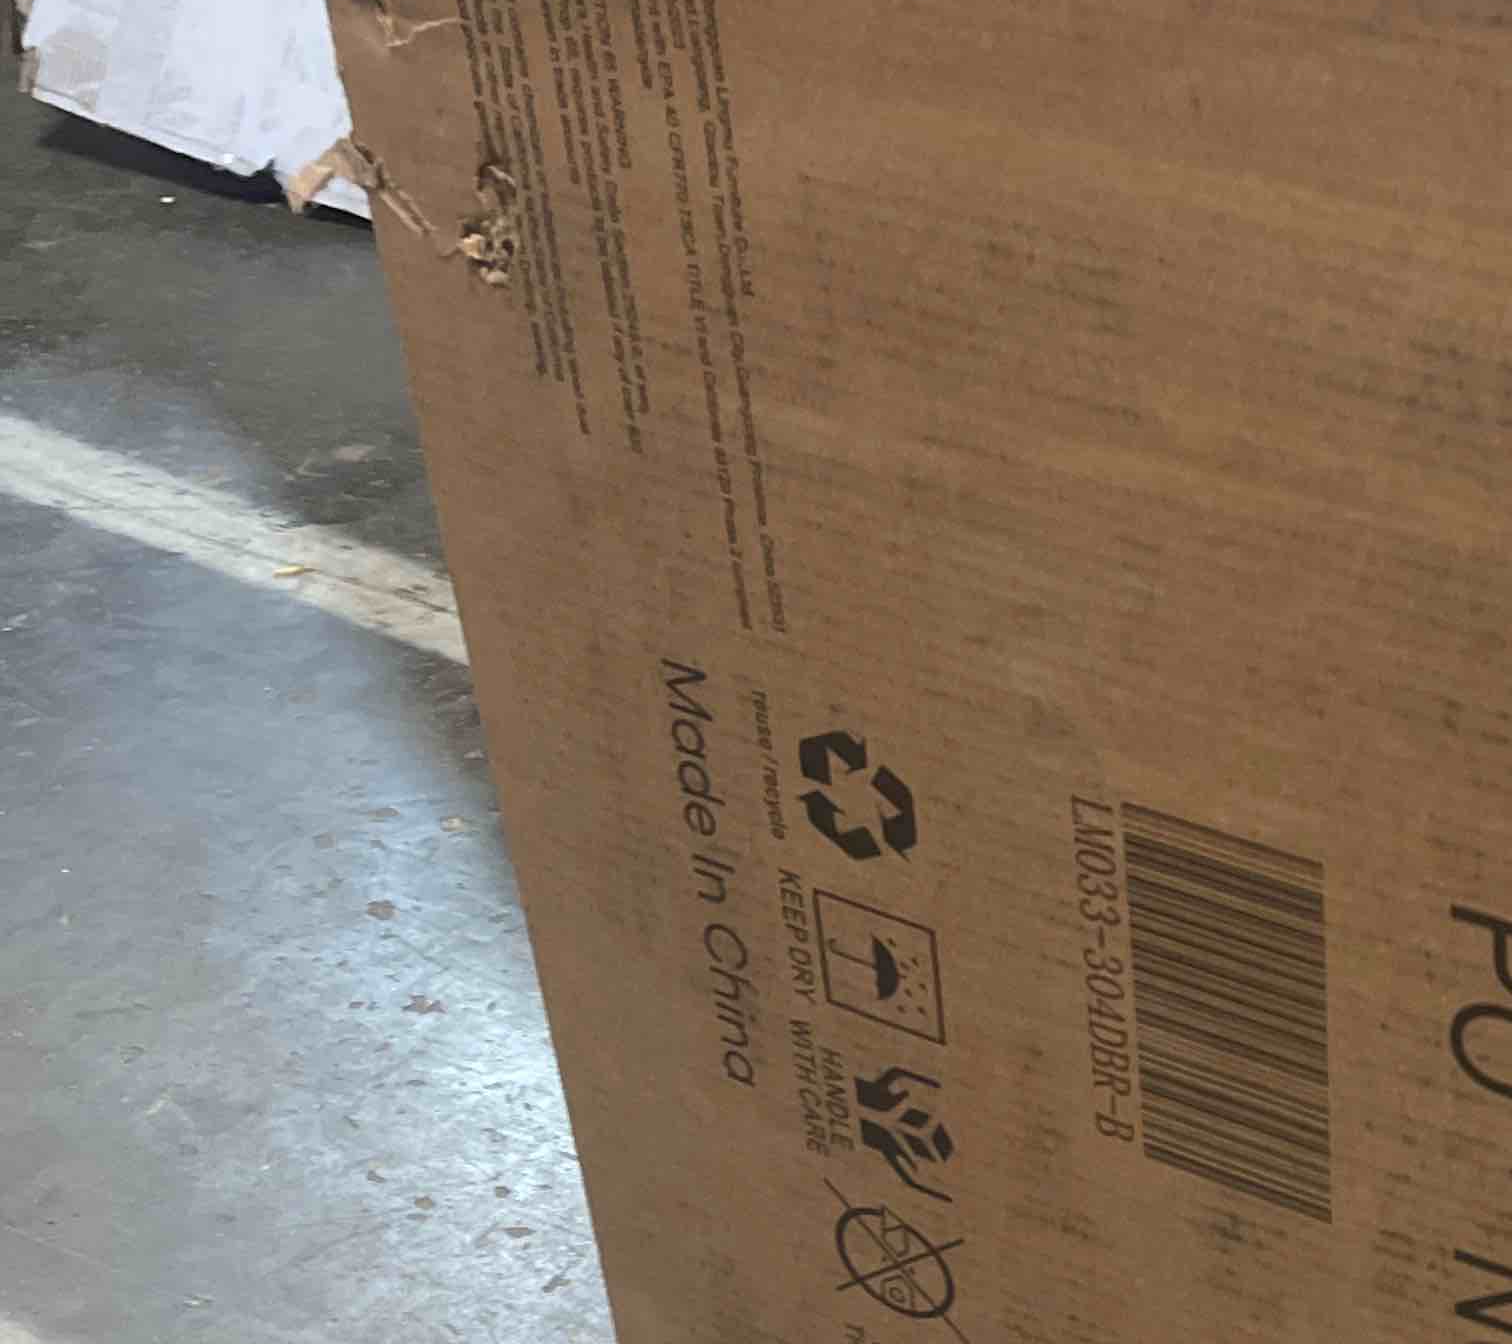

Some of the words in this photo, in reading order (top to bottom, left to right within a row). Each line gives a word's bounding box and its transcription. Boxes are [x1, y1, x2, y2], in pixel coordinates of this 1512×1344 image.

[660, 657, 726, 838] Made
[691, 852, 736, 906] In
[778, 867, 809, 945] KEEP
[702, 922, 756, 1090] China
[788, 945, 817, 1008] DRY
[1070, 794, 1136, 1144] LM033-304DBR-B
[789, 1017, 819, 1085] WITH
[799, 1085, 830, 1158] CARE
[818, 1045, 855, 1154] HANDLE
